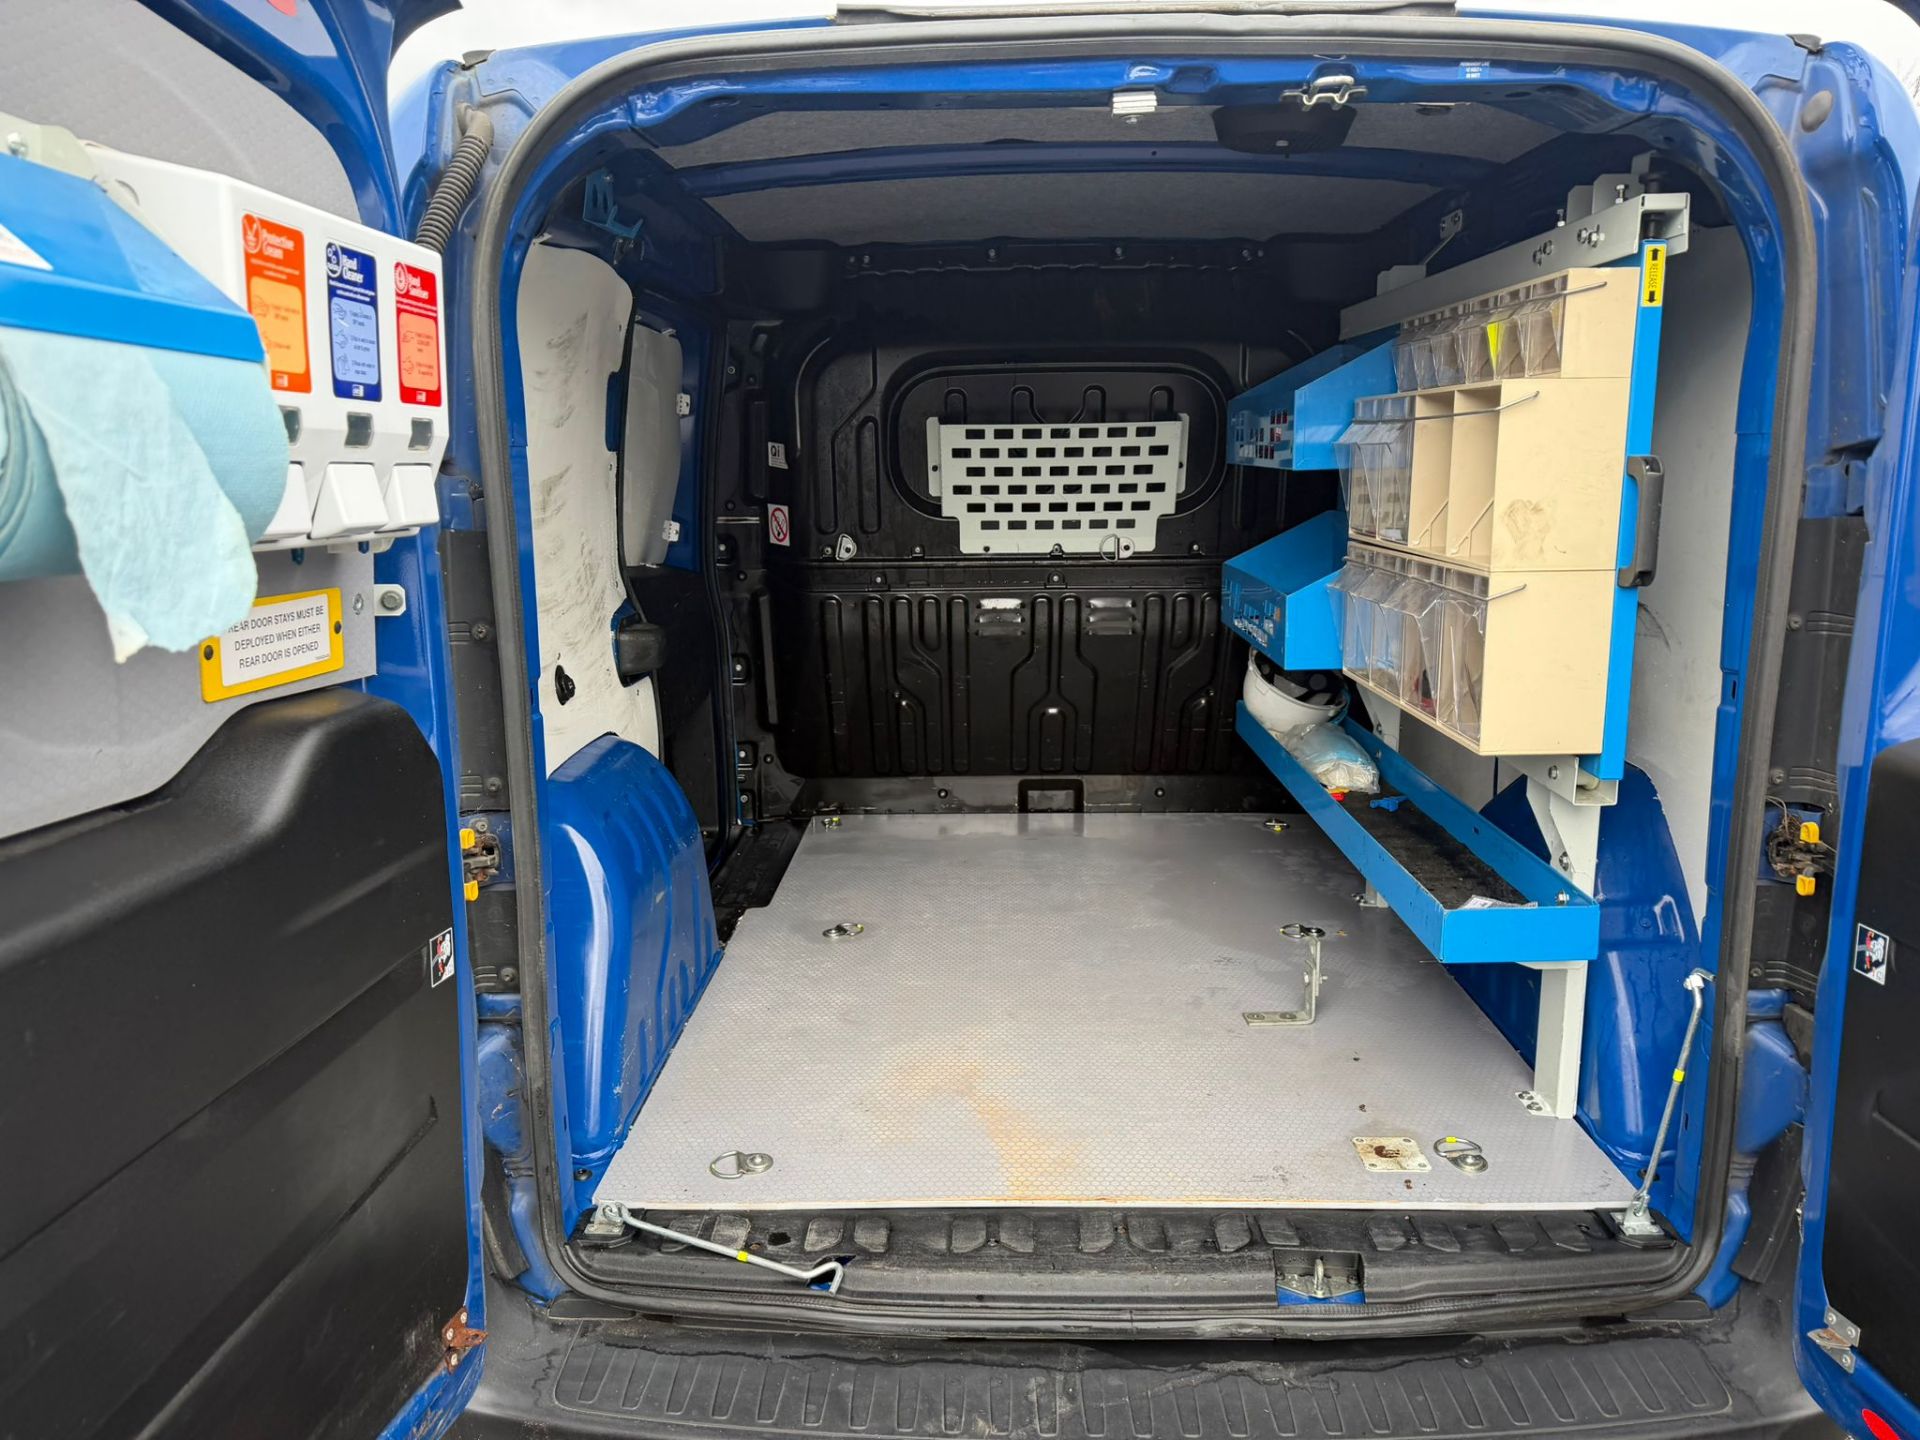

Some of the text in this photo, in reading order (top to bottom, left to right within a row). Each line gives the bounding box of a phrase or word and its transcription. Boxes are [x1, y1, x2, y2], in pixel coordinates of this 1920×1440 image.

[261, 227, 295, 251] Protective
[342, 254, 357, 270] Hand
[343, 267, 364, 283] Cleaner
[1648, 263, 1658, 289] RELEASE
[250, 616, 273, 630] DOOR
[274, 612, 295, 625] STAYS
[296, 607, 314, 620] MUST
[316, 605, 324, 616] BE
[234, 623, 321, 651] DEPLOYED WHEN EITHER
[239, 655, 261, 669] REAR
[261, 650, 283, 664] DOOR
[284, 648, 291, 658] IS
[292, 640, 319, 656] OPENED
